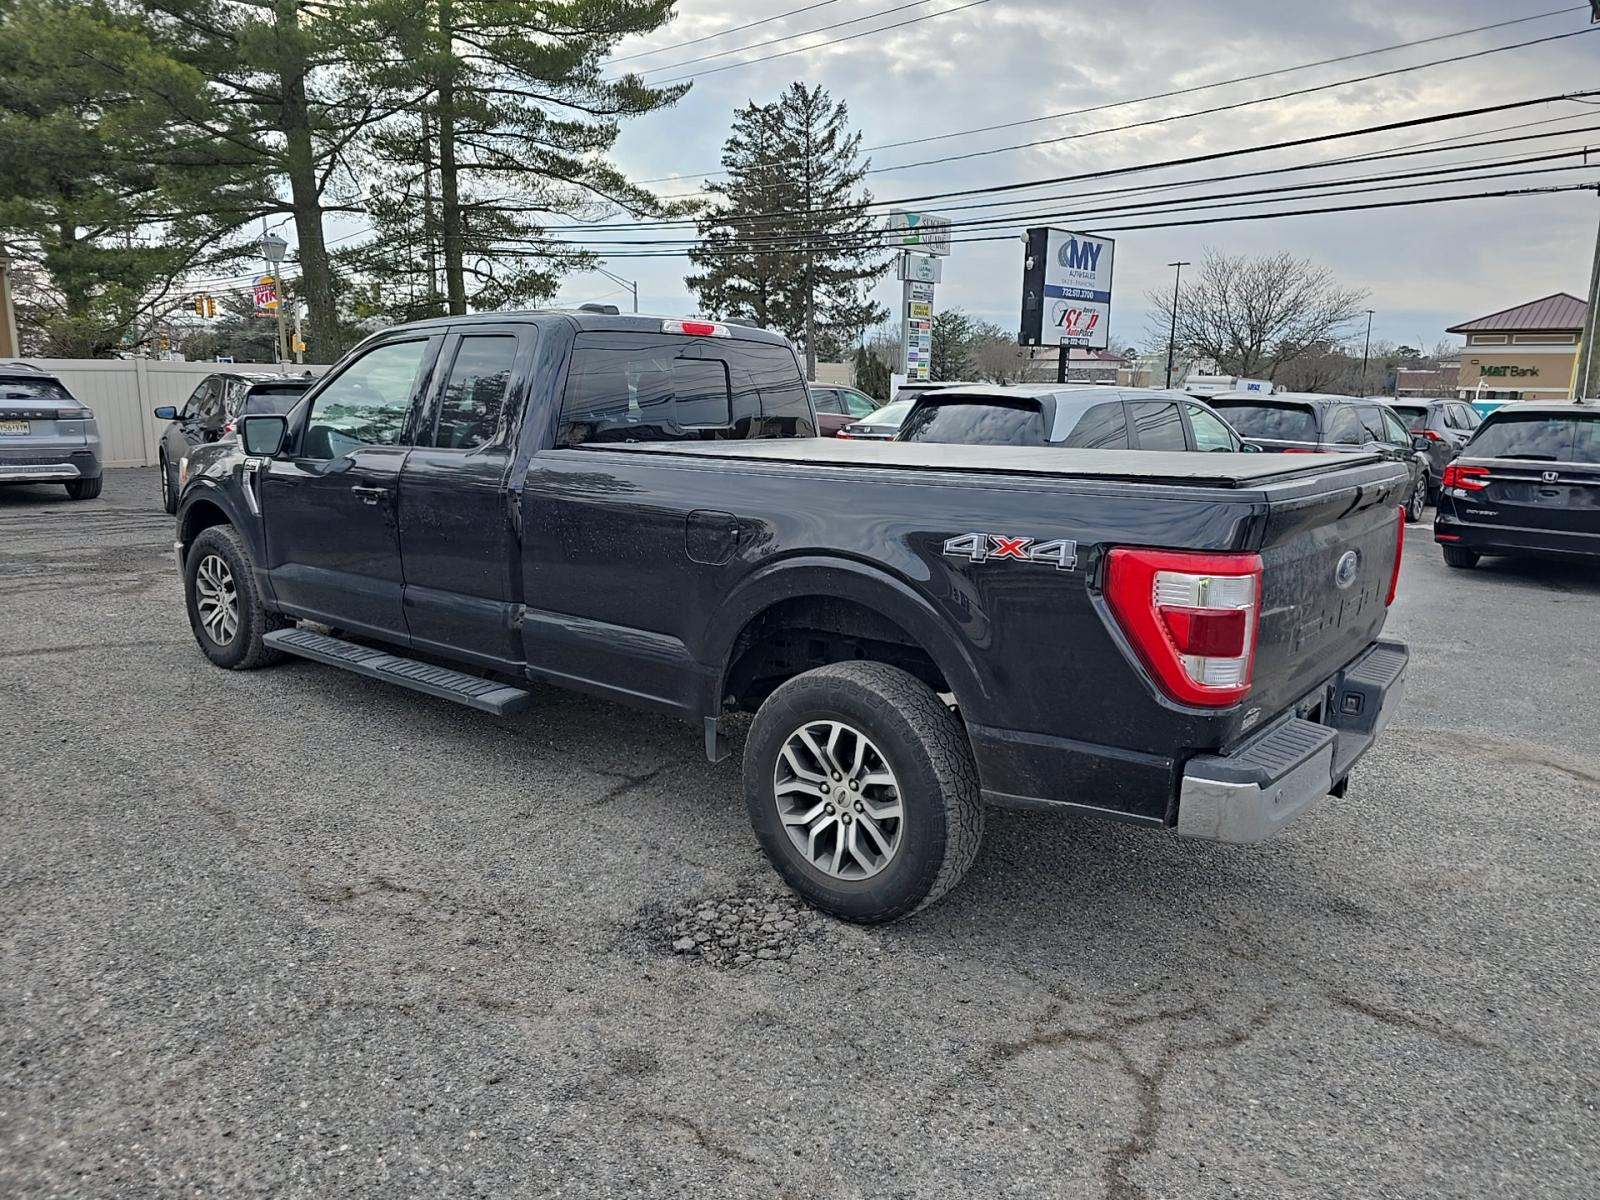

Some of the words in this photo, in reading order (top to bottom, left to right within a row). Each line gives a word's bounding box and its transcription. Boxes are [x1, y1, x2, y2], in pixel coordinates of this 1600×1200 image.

[1069, 239, 1104, 271] MY
[255, 290, 277, 305] KIN
[913, 309, 929, 317] GENERAL
[1510, 365, 1540, 377] Bank
